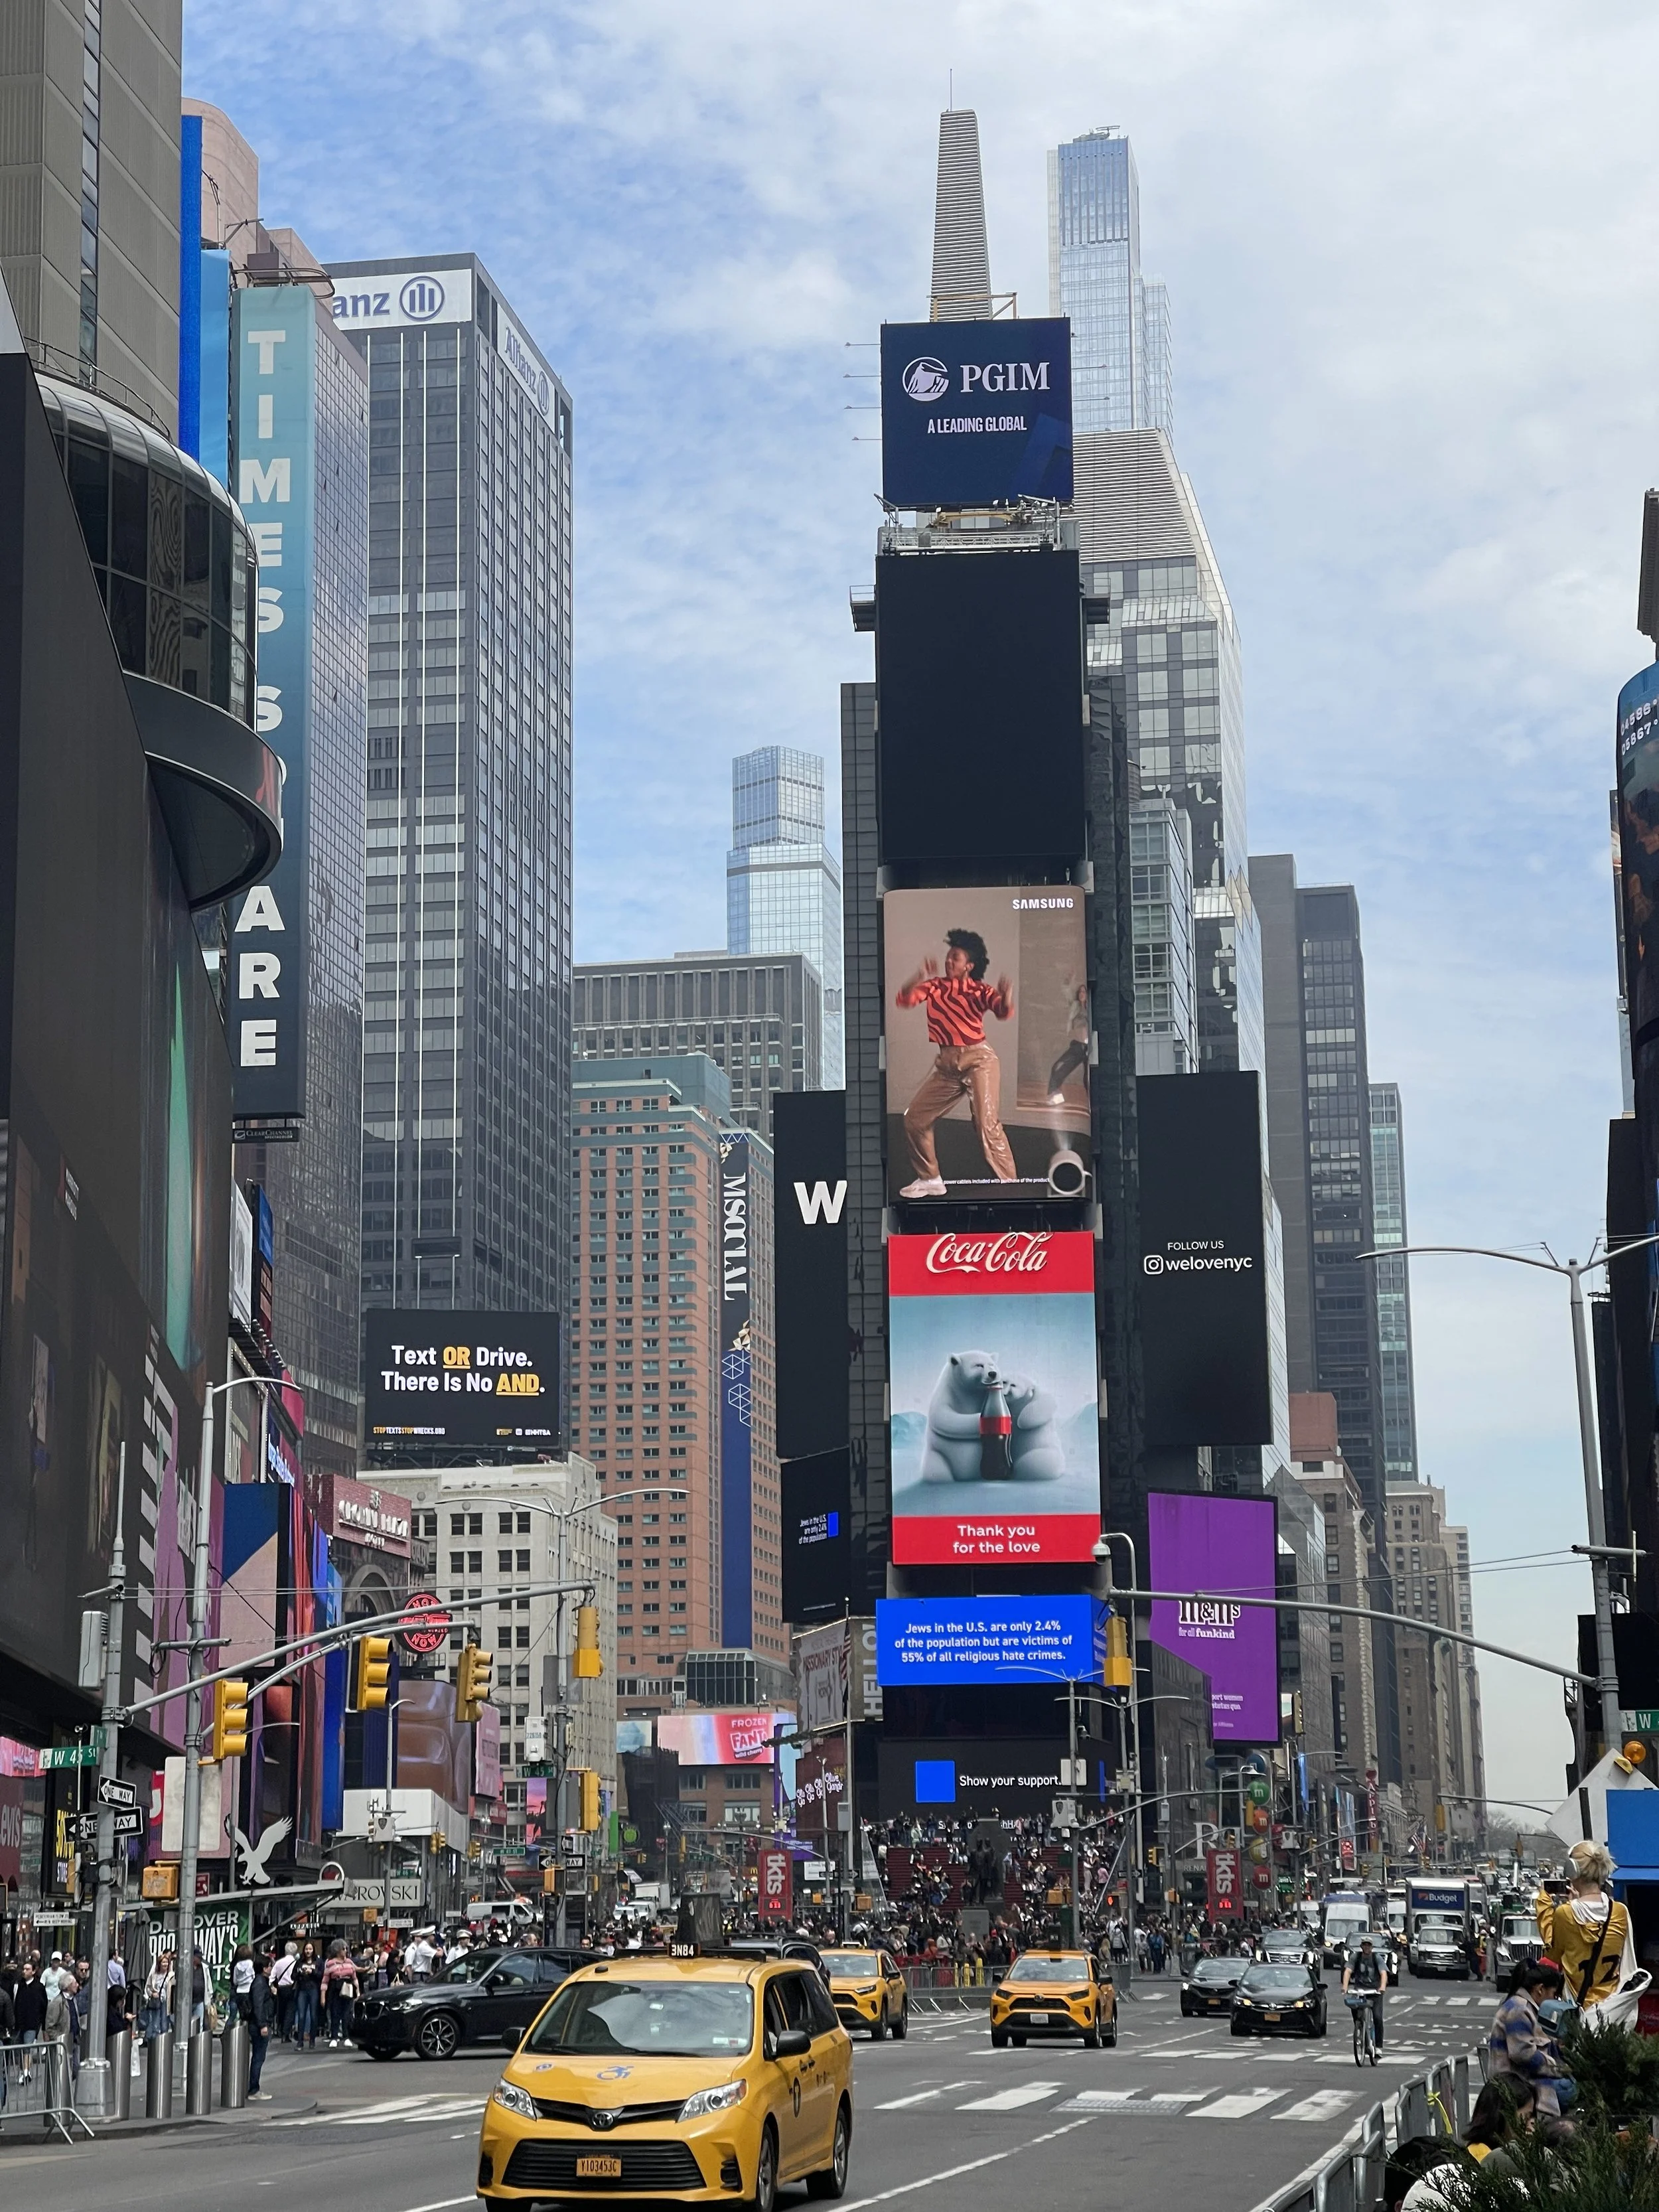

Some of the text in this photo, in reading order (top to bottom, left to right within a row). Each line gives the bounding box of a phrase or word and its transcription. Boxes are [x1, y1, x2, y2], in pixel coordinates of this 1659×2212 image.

[504, 326, 536, 394] Allianz
[960, 362, 1050, 393] PGIM
[927, 415, 1027, 434] A LEADING GLOBAL
[235, 330, 291, 1067] TIMES SARE
[1012, 898, 1074, 910] SAMSUNG
[793, 1181, 847, 1225] W
[926, 1232, 1054, 1274] Coca-Cola
[1167, 1240, 1225, 1251] FOLLOW US
[1165, 1256, 1253, 1272] welovenyc
[391, 1345, 533, 1368] Text OR Drive.
[381, 1370, 545, 1396] There Is No AND.
[373, 1426, 446, 1435] STOPTEXTSSTOPWRECKS.ORG
[958, 1524, 1035, 1538] Thank you
[953, 1540, 1041, 1554] for the love
[905, 1621, 1061, 1635] Jews in the U.S. are only 2.4%
[1196, 1628, 1236, 1639] funkind
[895, 1635, 1073, 1650] of the population but are victims of
[901, 1651, 1066, 1664] 55% of all religious hate crimes.
[731, 1718, 768, 1728] FROZEN
[1638, 1714, 1651, 1729] W
[54, 1751, 64, 1765] W
[70, 1749, 83, 1764] 45
[747, 1747, 763, 1757] cherry
[524, 1767, 532, 1777] W
[534, 1767, 545, 1777] 45
[960, 1775, 1062, 1787] Show your support.
[104, 1785, 131, 1802] ONE WAY
[766, 1854, 786, 1895] tkts
[1215, 1853, 1236, 1894] tkts
[1429, 1893, 1457, 1904] Budget
[671, 1944, 694, 1956] 3N84
